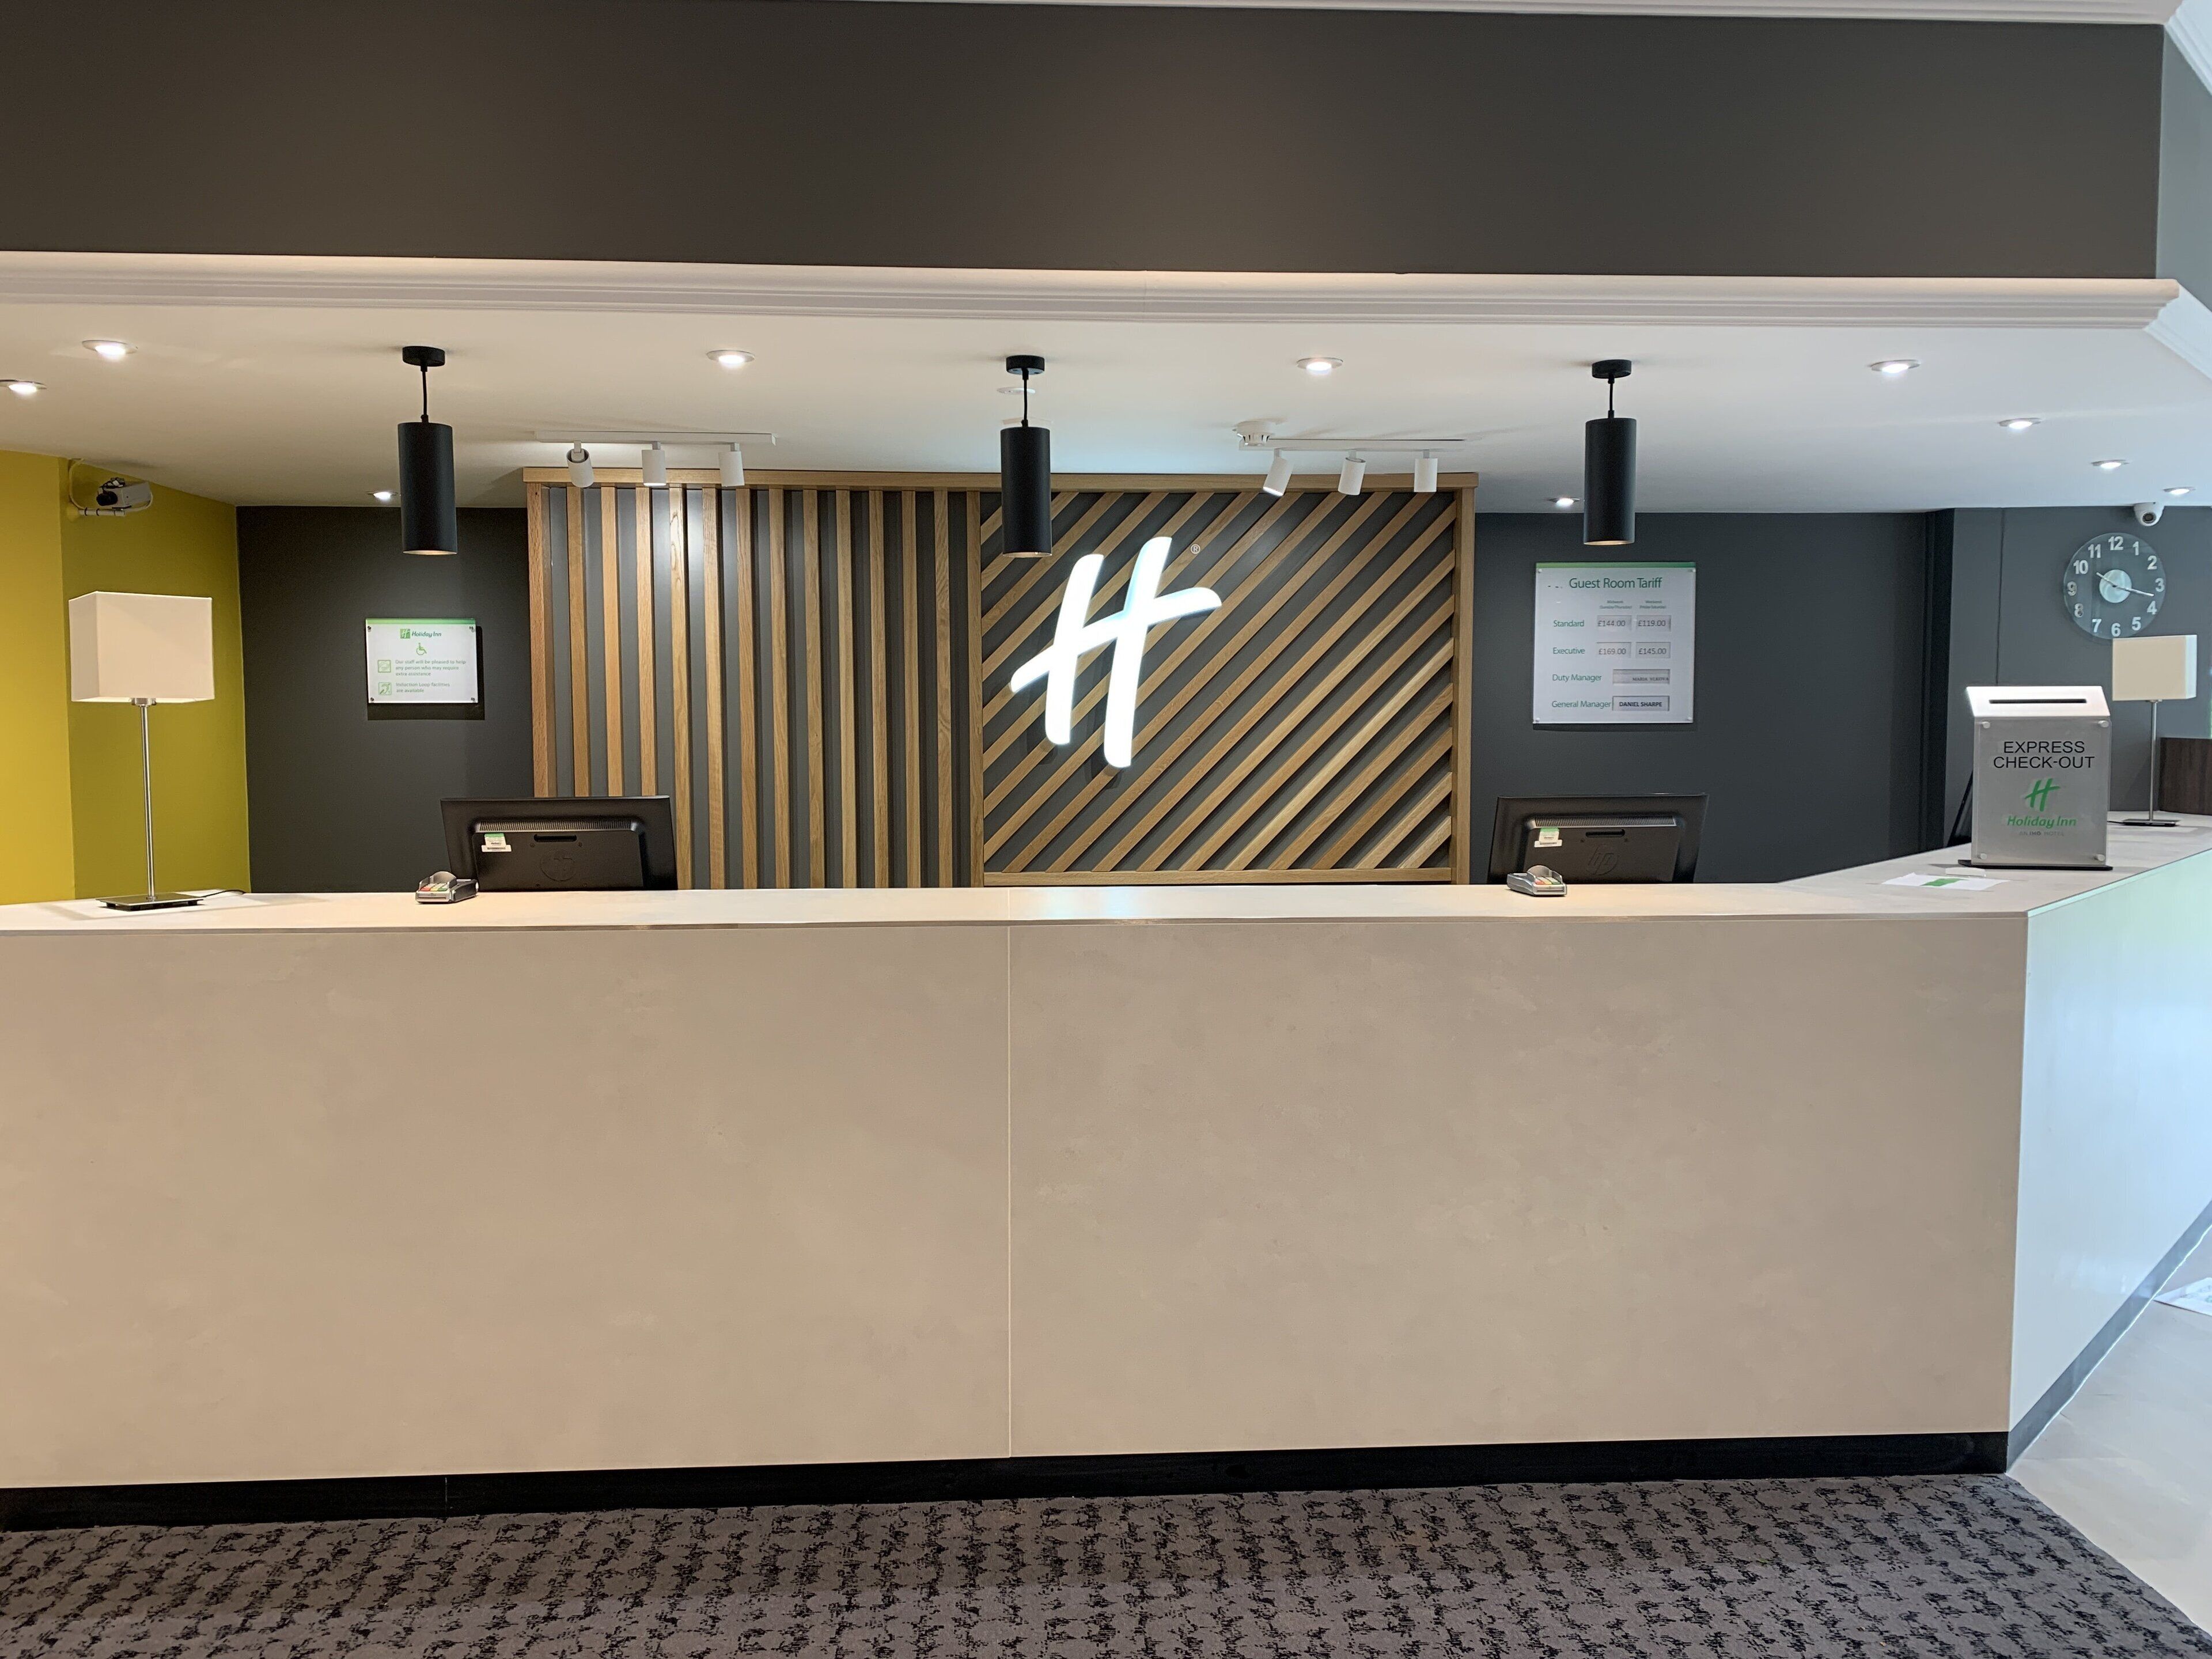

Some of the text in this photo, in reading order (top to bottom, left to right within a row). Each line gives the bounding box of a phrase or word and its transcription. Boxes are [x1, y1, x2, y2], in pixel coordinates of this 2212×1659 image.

[2108, 536, 2123, 551] 12
[2133, 541, 2139, 555] 1
[2088, 544, 2101, 558] 11
[2073, 560, 2088, 574] 10
[2147, 555, 2157, 570] 2
[1569, 577, 1662, 588] Guest Room Tariff
[2067, 581, 2077, 596] 9
[2154, 578, 2165, 592] 3
[2074, 603, 2084, 618] 8
[2146, 600, 2157, 615] 4
[2092, 619, 2102, 632] 7
[2111, 623, 2121, 637] 6
[2131, 616, 2142, 631] 5
[1010, 536, 1222, 768] H
[1552, 674, 1569, 682] Duty
[1580, 701, 1611, 709] Manager
[2003, 741, 2085, 753] EXPRESS
[1994, 756, 2095, 768] CHECK-OUT
[2024, 778, 2061, 812] H
[2007, 816, 2077, 829] Holiday Inn
